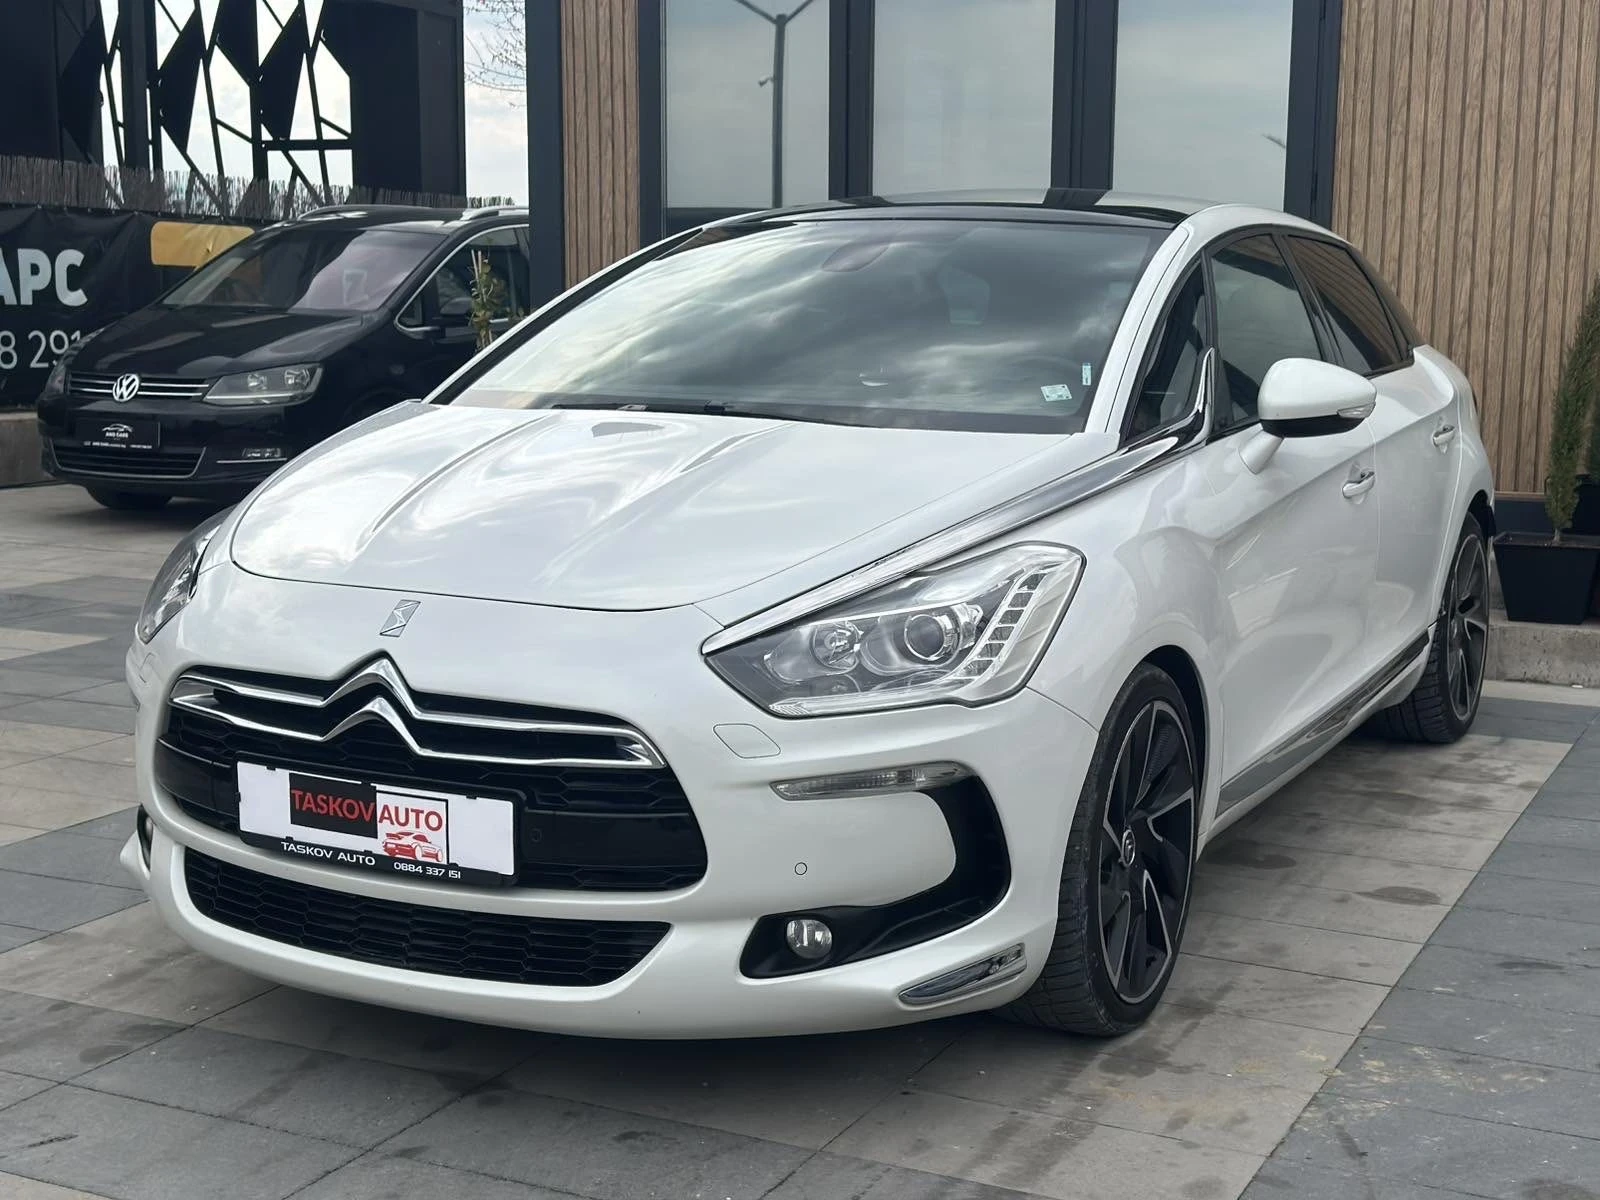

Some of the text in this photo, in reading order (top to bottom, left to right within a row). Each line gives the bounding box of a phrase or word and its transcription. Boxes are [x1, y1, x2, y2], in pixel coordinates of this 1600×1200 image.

[28, 330, 81, 368] 29
[291, 789, 443, 832] TASKOV AUTO
[281, 841, 461, 879] TASKOV AUTO 0884 337 151
